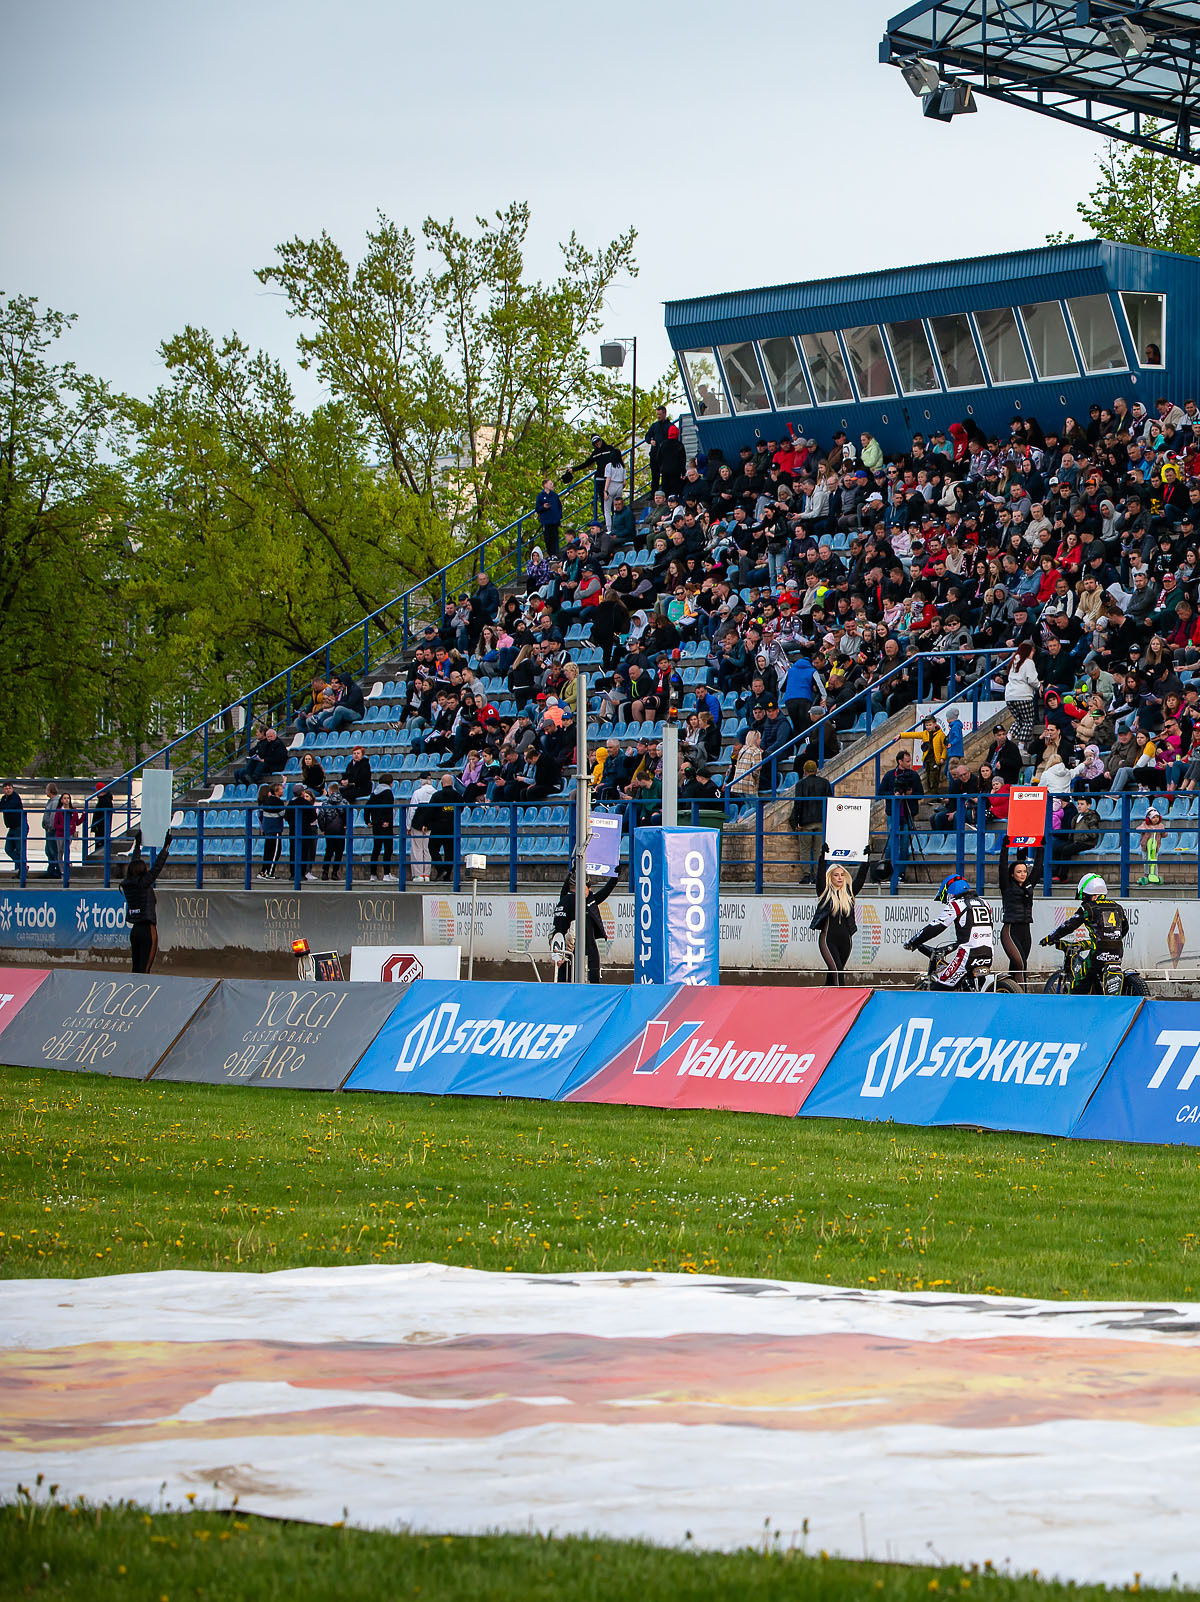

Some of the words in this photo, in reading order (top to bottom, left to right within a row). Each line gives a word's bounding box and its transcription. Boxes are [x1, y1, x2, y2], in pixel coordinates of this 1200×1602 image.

[14, 901, 56, 928] trodo
[175, 897, 209, 918] YOGGI
[264, 898, 300, 920] YOGGI
[357, 899, 396, 922] YOGGI
[639, 849, 652, 968] trodo
[680, 850, 705, 969] trodo
[884, 906, 930, 922] DAUGAVPILS
[974, 908, 989, 922] 12
[1108, 912, 1117, 927] 4
[75, 981, 161, 1018] YOGGI
[255, 990, 350, 1029] YOGGI
[61, 1017, 134, 1033] GASTROBĀRS
[242, 1029, 322, 1044] GASTROBĀRS
[441, 1019, 578, 1060] STOKKER
[677, 1038, 816, 1084] Valvoline
[915, 1036, 1081, 1086] STOKKER
